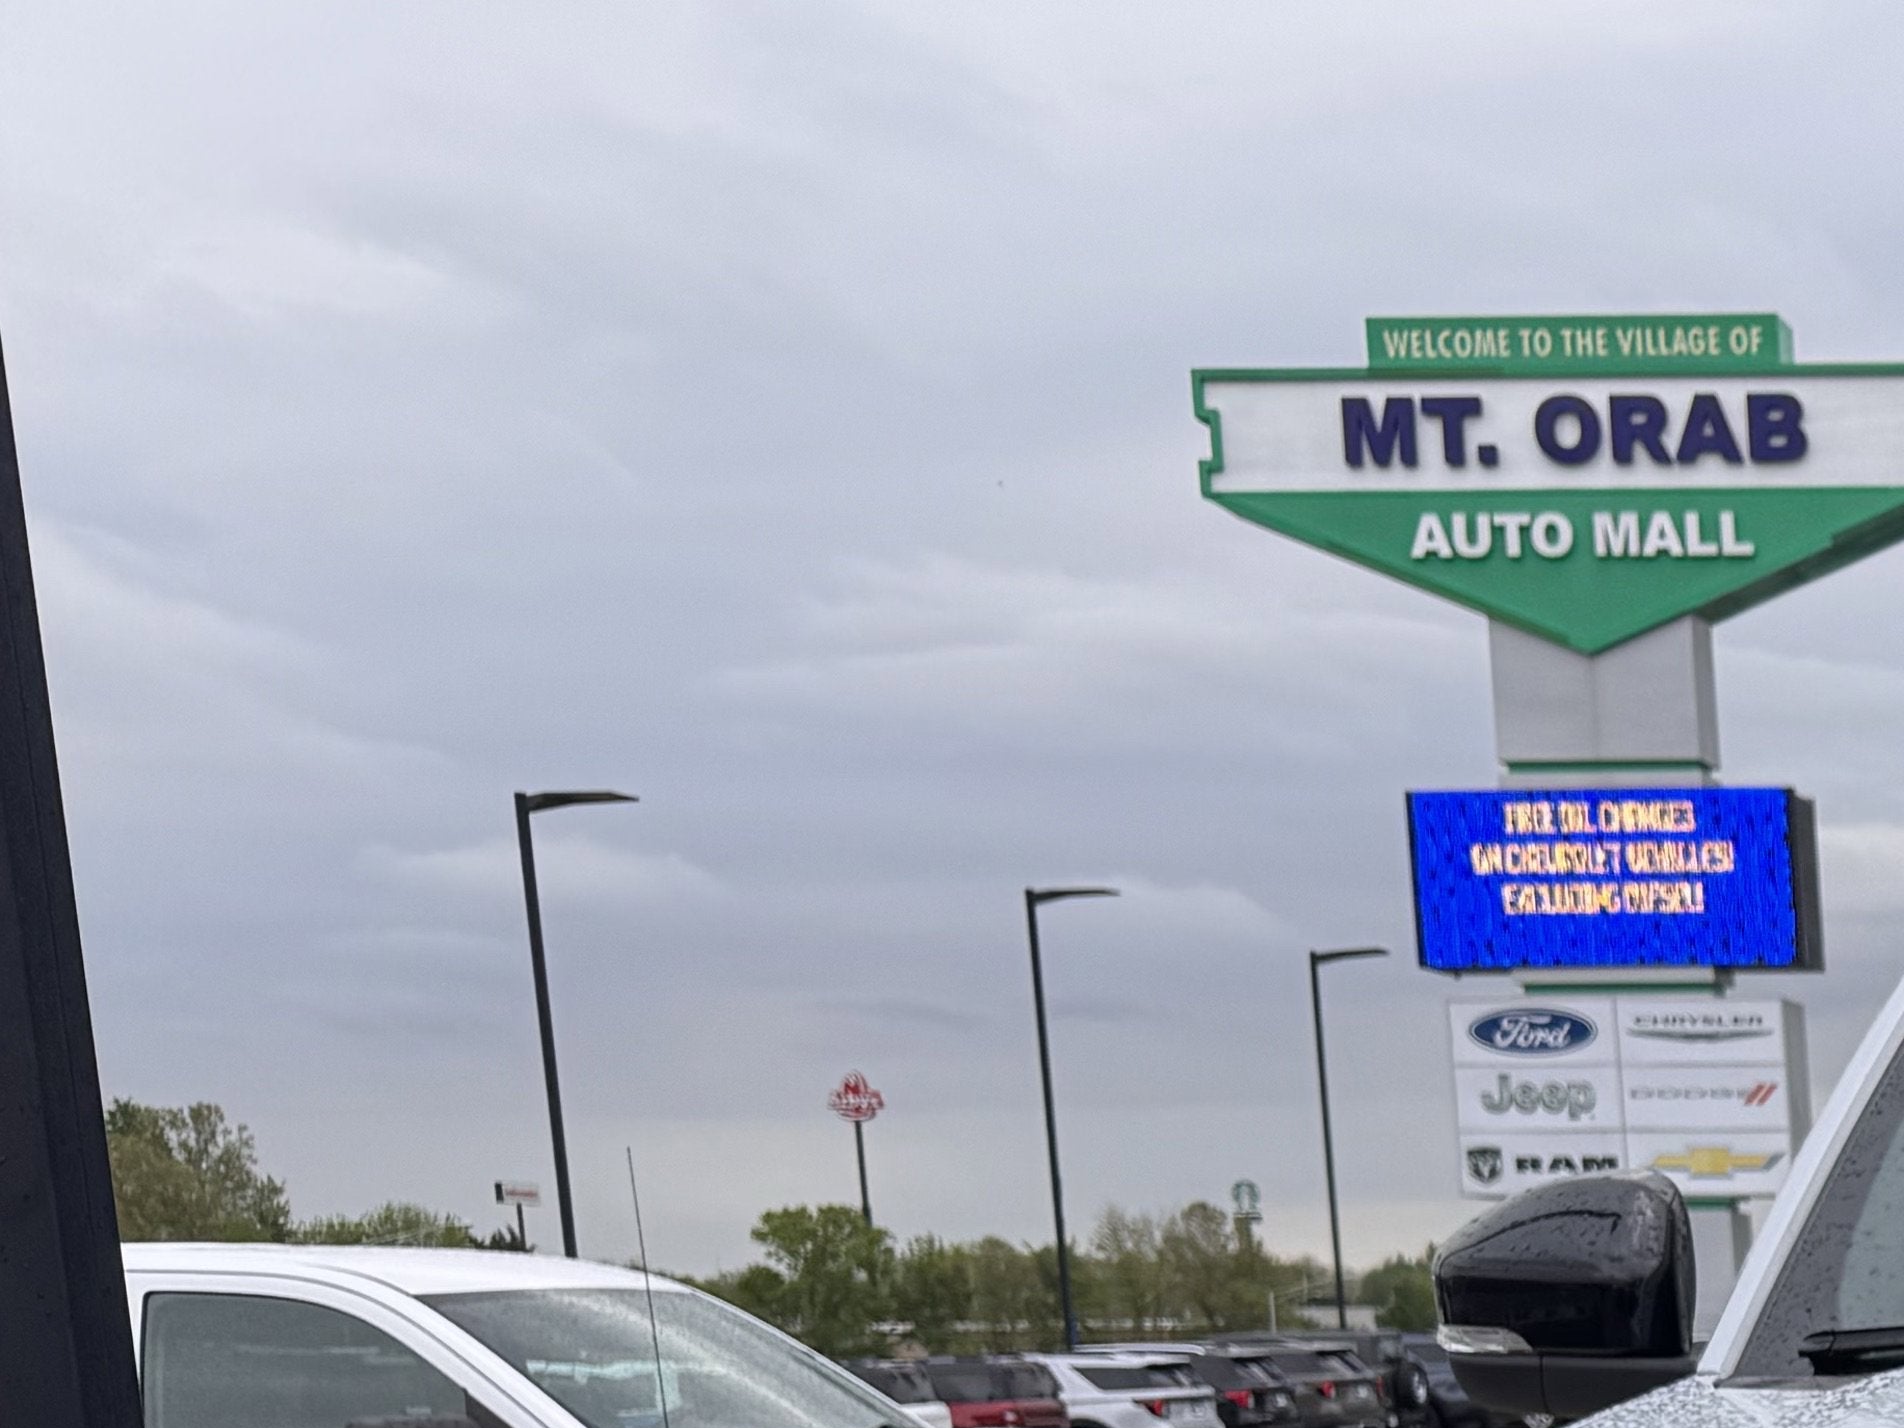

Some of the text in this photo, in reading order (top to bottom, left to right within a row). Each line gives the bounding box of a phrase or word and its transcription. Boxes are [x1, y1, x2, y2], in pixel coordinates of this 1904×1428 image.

[1383, 326, 1762, 359] WELCOME TO THE VILLAGE OF
[1341, 392, 1810, 467] MT. ORAB
[1411, 510, 1755, 559] AUTO MALL
[1493, 1015, 1571, 1049] Ford
[1482, 1074, 1596, 1121] Jeep
[1515, 1155, 1619, 1173] RAM
